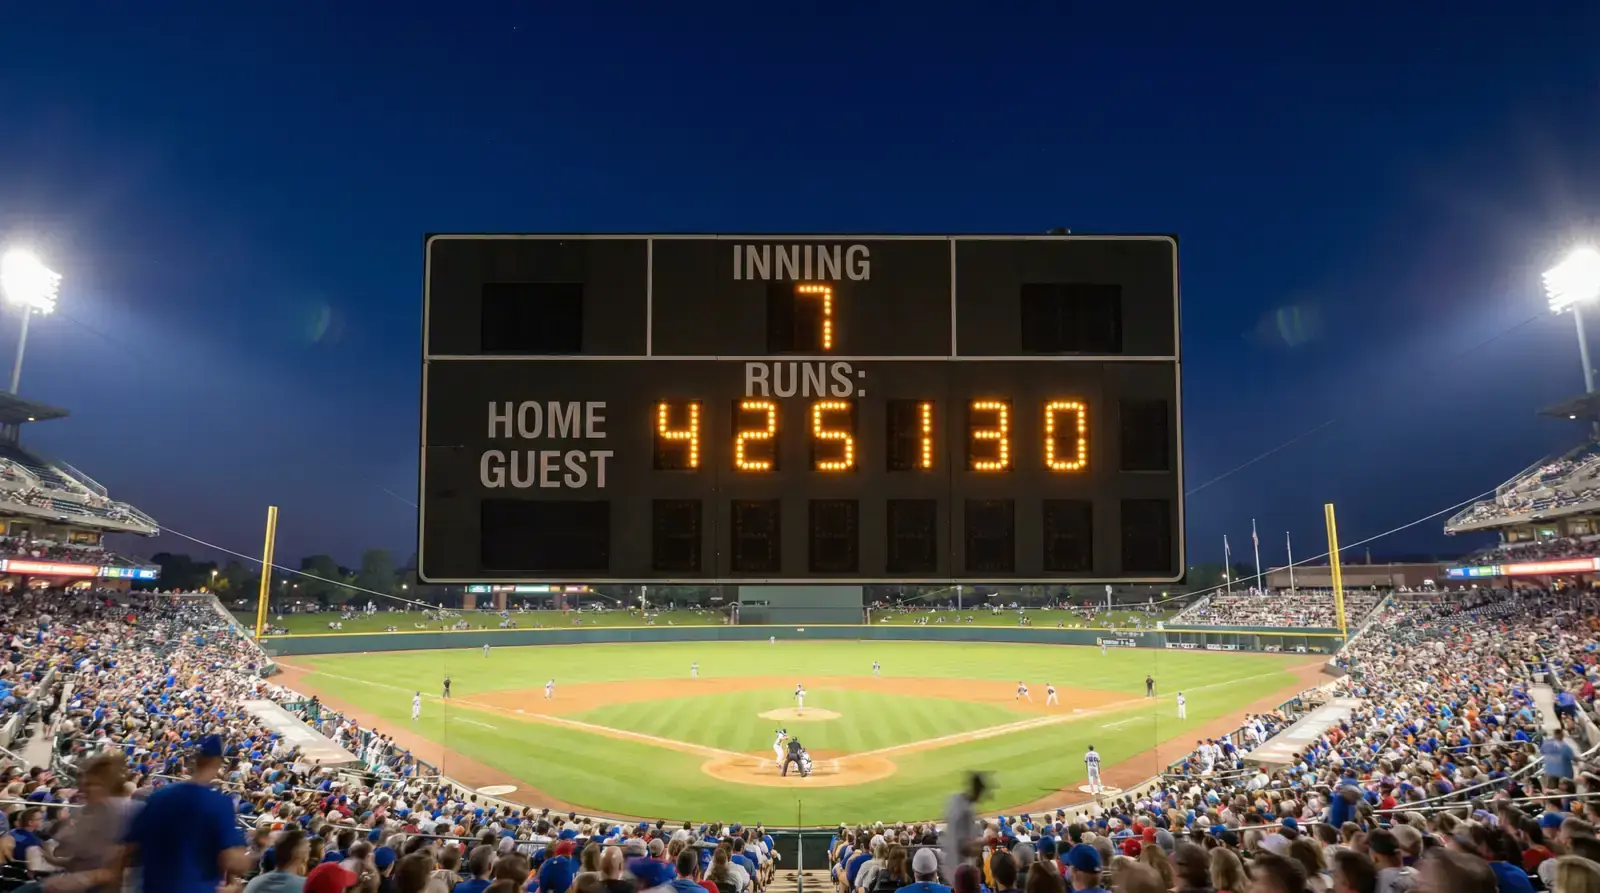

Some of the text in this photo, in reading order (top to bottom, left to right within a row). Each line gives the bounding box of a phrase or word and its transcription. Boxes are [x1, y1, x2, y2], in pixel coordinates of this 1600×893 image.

[733, 244, 871, 281] INNING
[798, 284, 833, 349] 7
[745, 361, 866, 398] RUNS:
[488, 401, 607, 439] HOME
[657, 400, 1088, 472] 4 2 5 1 3 0
[479, 450, 614, 488] GUEST
